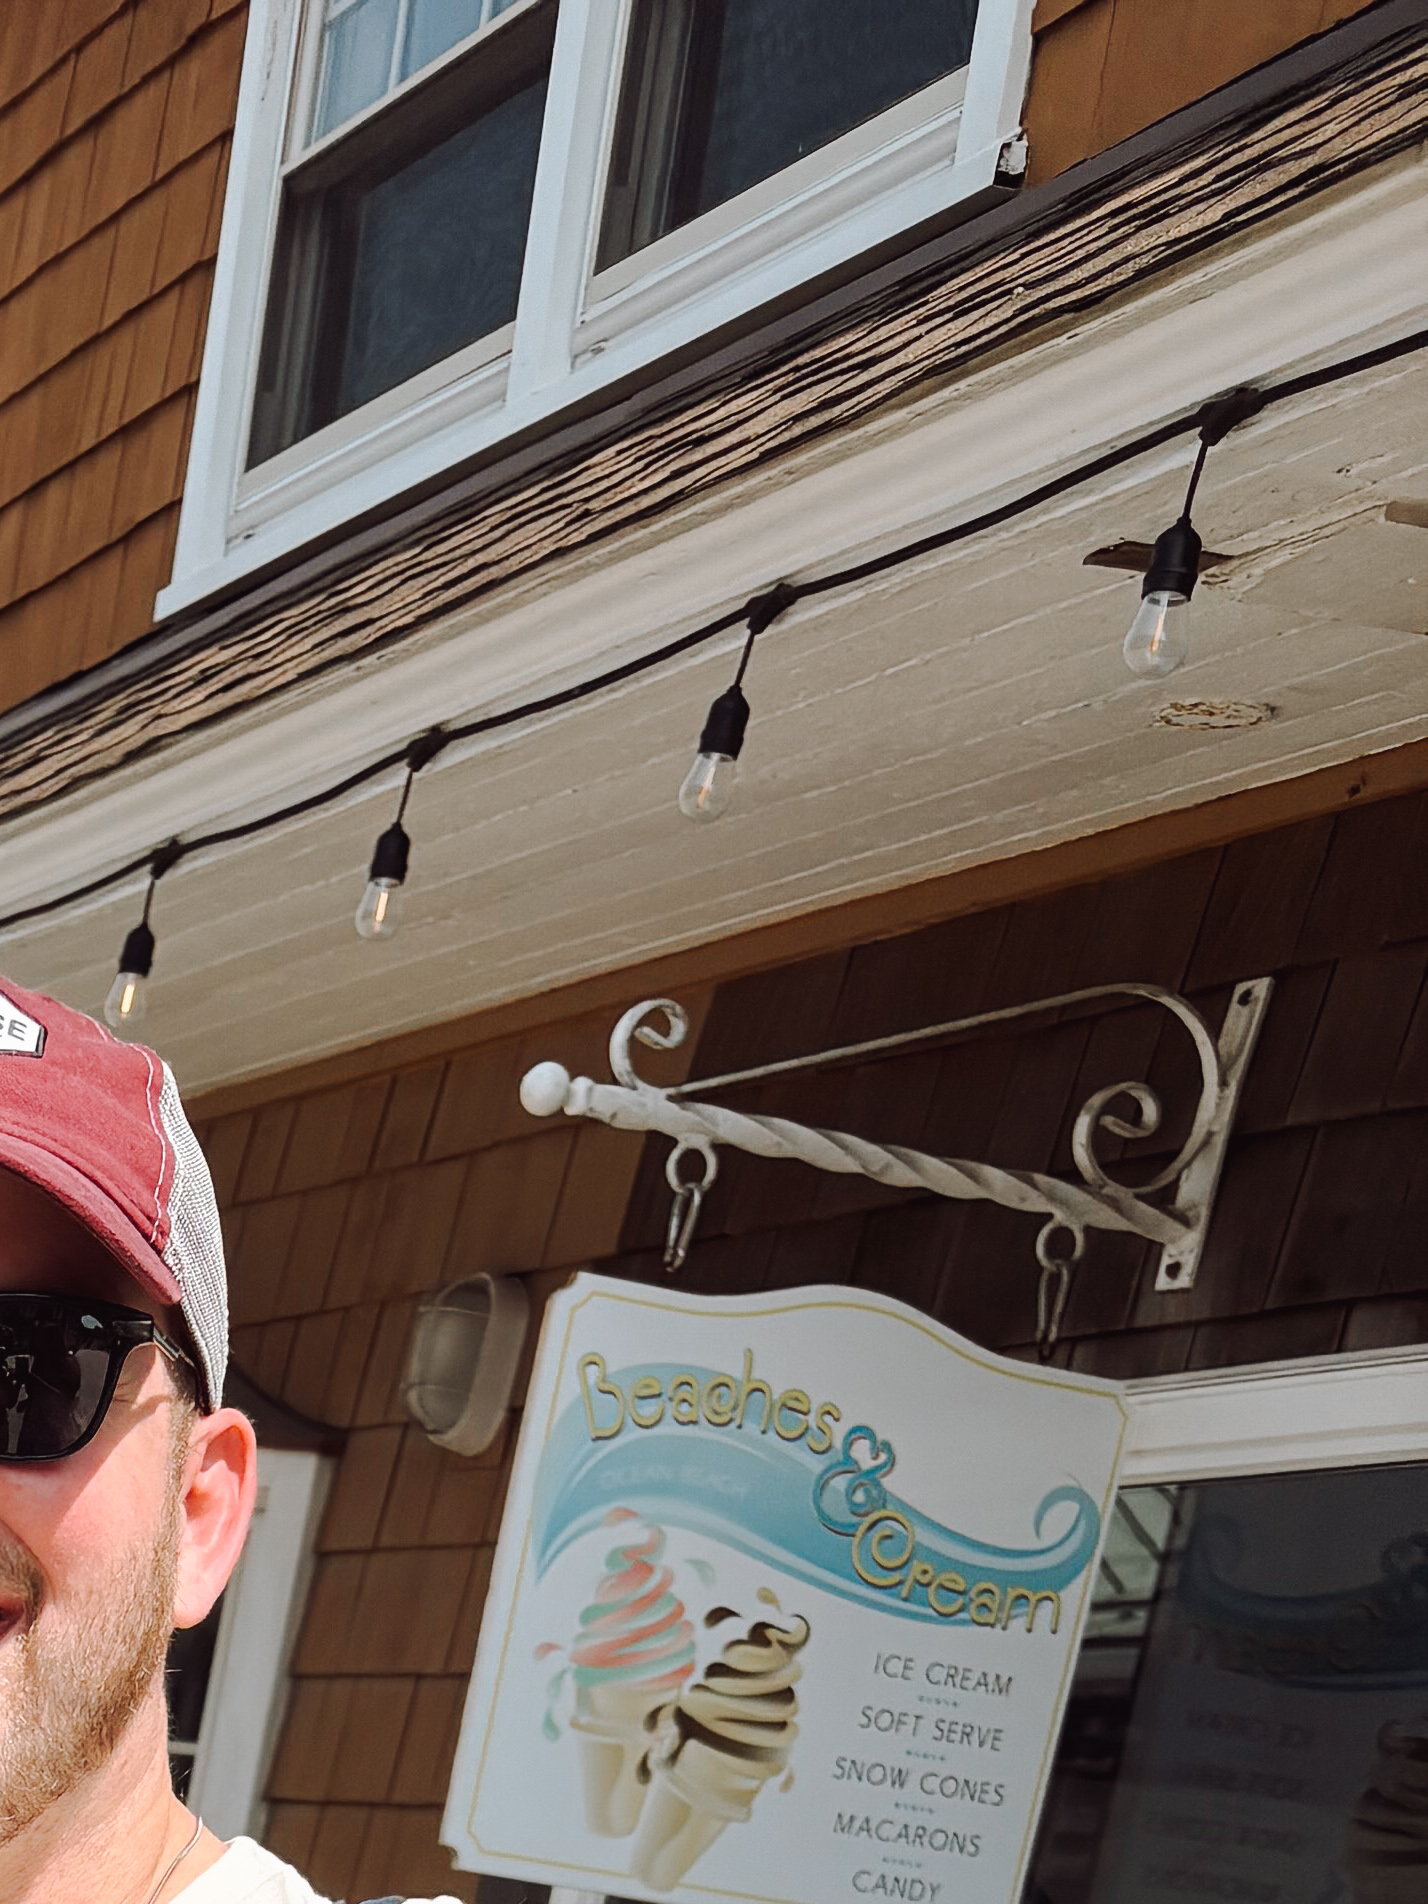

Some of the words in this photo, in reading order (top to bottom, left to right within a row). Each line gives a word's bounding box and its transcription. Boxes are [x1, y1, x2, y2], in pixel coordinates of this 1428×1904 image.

[577, 1346, 842, 1455] Beaches
[812, 1423, 897, 1538] &
[851, 1507, 1062, 1635] Cream
[873, 1652, 915, 1681] ICE
[925, 1661, 1013, 1698] CREAM
[858, 1705, 924, 1738] SOFT
[932, 1718, 1005, 1752] SERVE
[832, 1755, 911, 1790] SNOW
[920, 1771, 1006, 1808] CONES
[833, 1811, 982, 1858] MACARONS
[851, 1868, 942, 1904] CANDY
